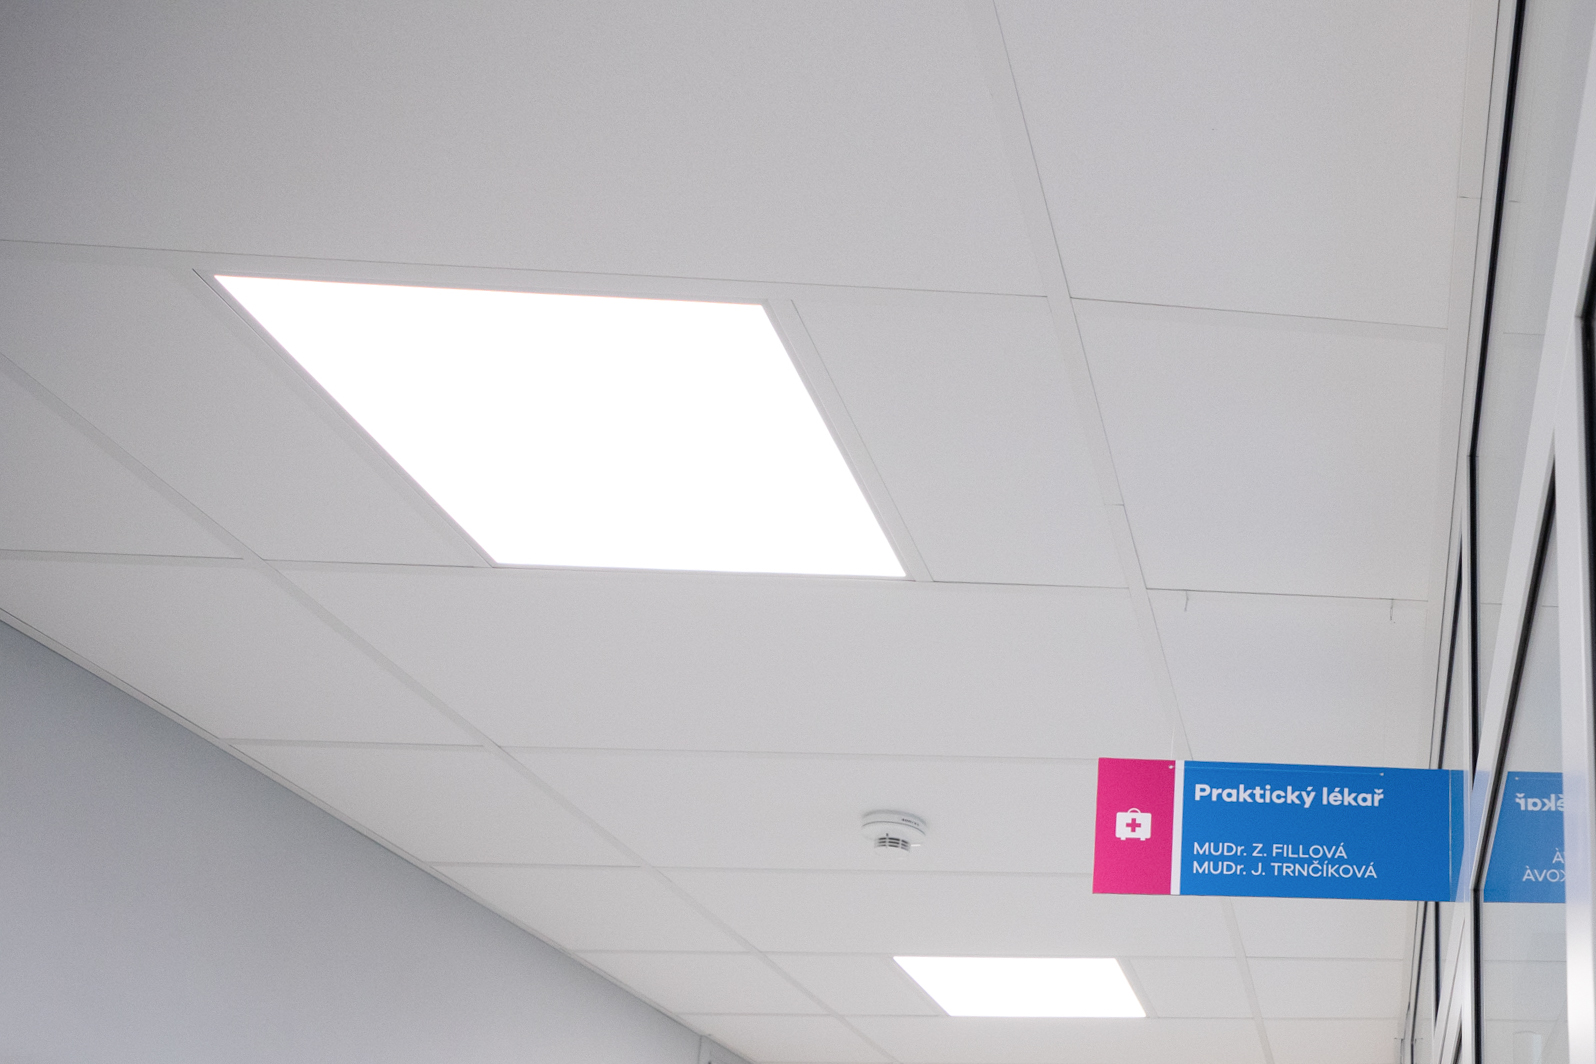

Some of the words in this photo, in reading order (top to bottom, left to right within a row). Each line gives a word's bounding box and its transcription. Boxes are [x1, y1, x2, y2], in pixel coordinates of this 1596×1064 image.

[1194, 784, 1317, 809] Praktický
[1322, 786, 1384, 808] lékař
[1193, 842, 1247, 857] MUDr.
[1252, 843, 1267, 857] Z.
[1273, 843, 1348, 860] FILLOVÁ
[1193, 861, 1247, 877] MUDr.
[1251, 862, 1266, 877] J.
[1271, 860, 1379, 879] TRNČÍKOVÁ
